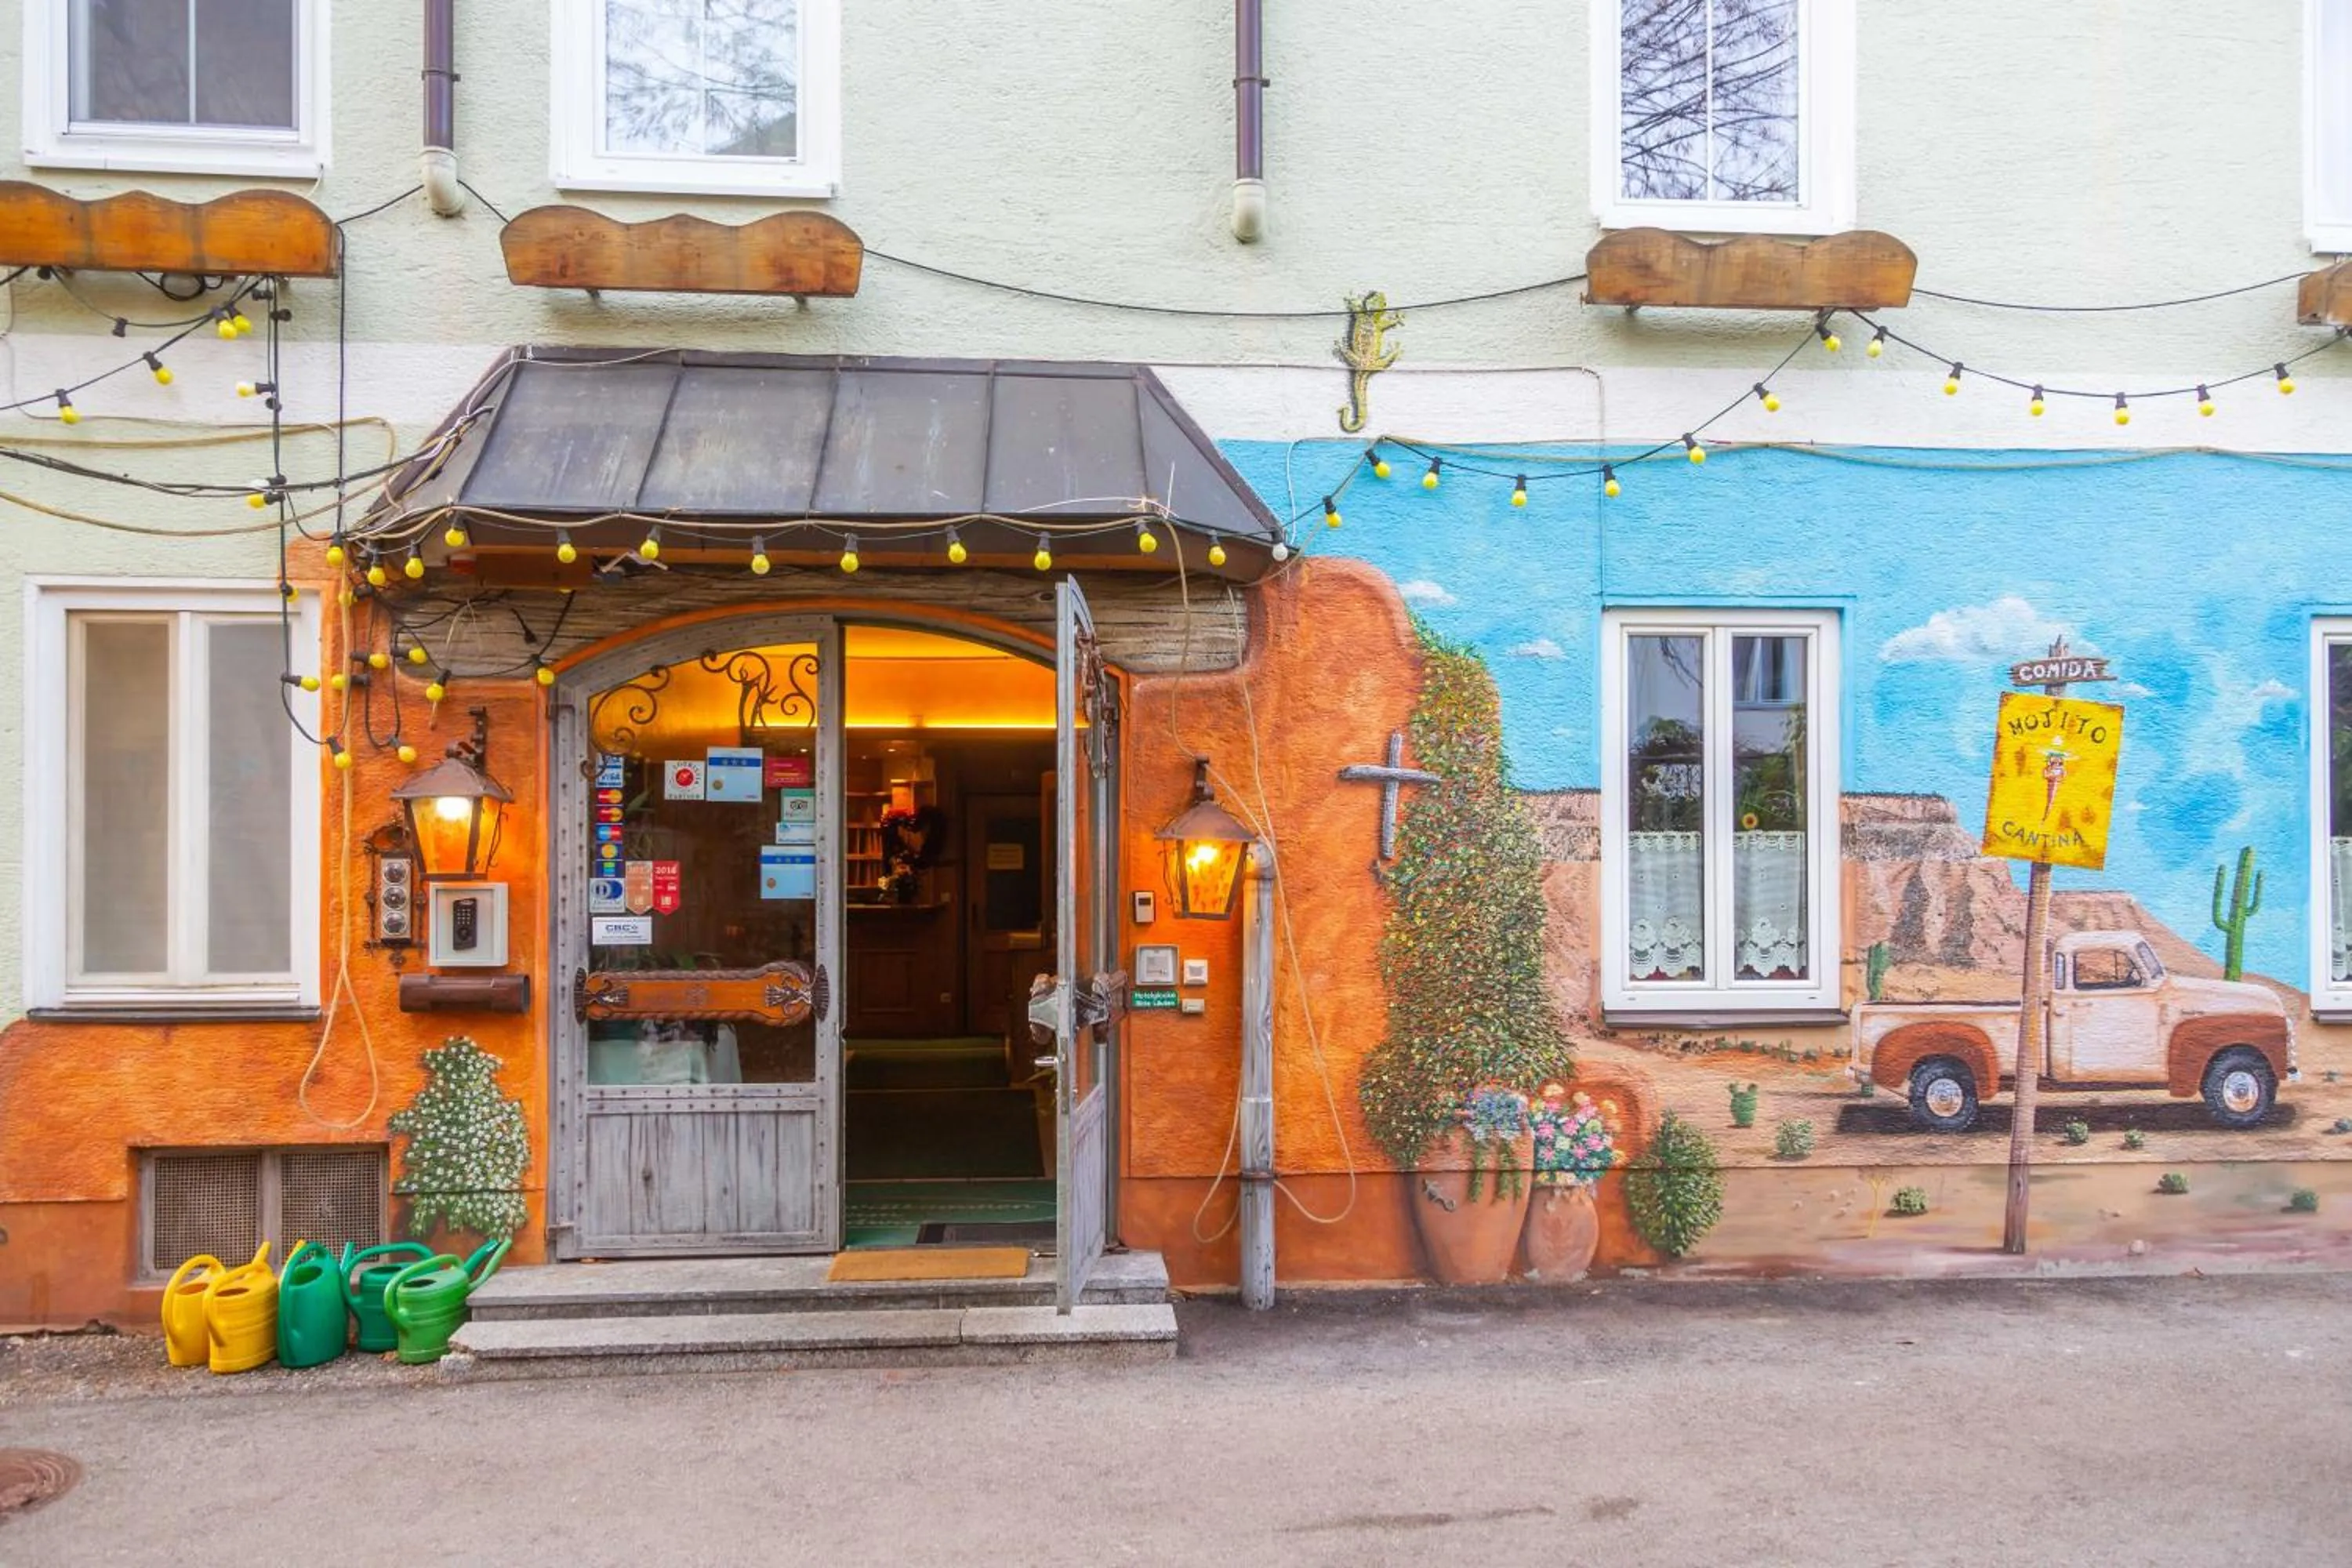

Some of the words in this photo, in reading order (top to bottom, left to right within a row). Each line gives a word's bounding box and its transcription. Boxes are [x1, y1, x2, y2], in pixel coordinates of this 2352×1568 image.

[2019, 660, 2097, 681] COMIDA
[2009, 708, 2107, 744] MOJITO
[2002, 822, 2085, 849] CANTINA
